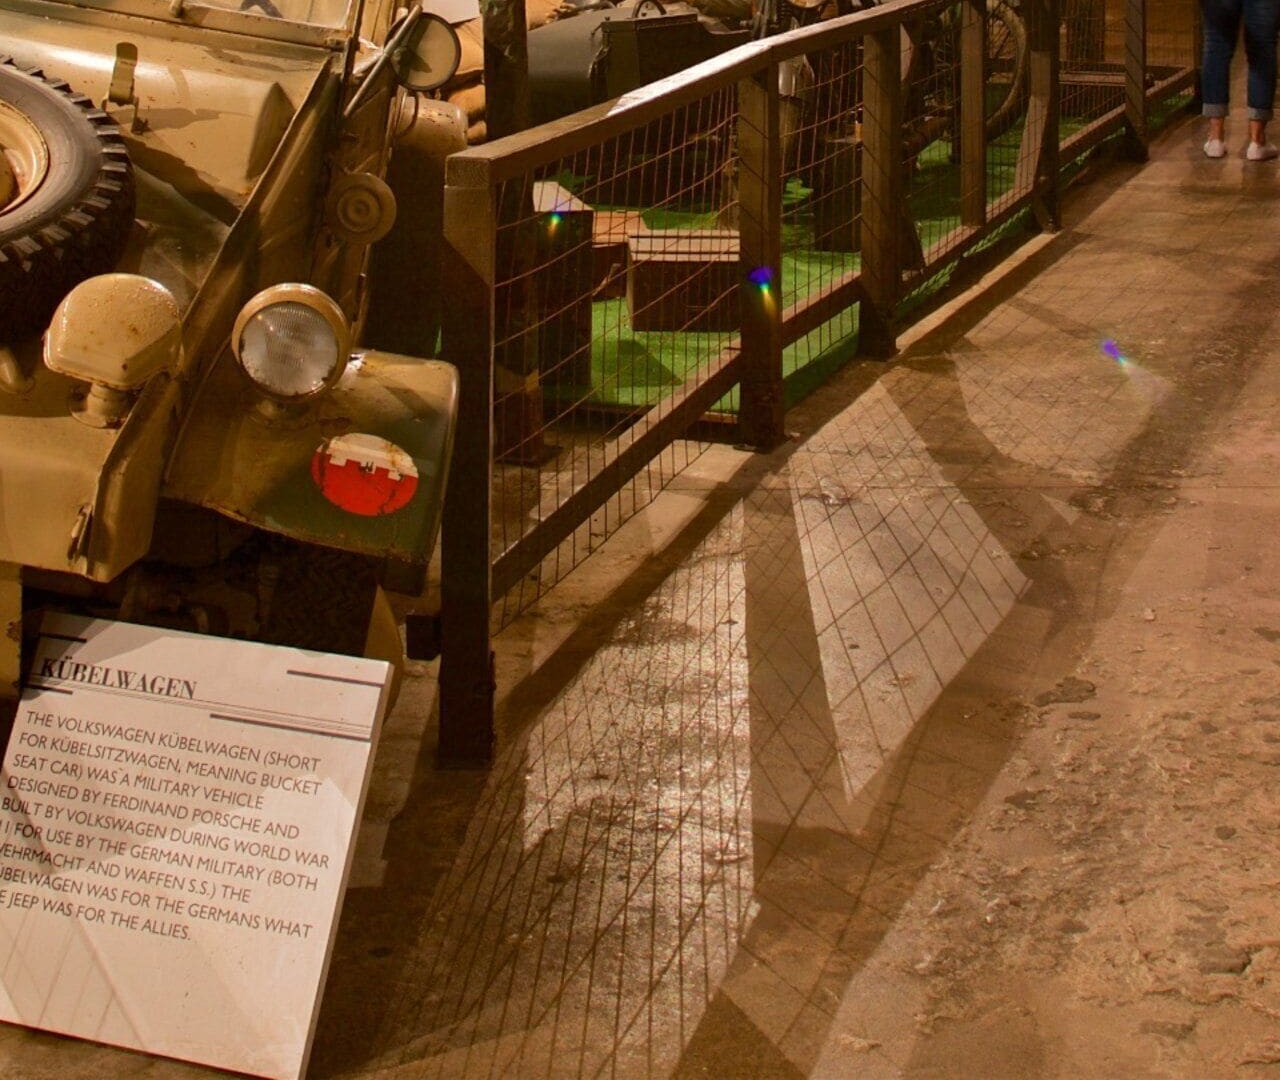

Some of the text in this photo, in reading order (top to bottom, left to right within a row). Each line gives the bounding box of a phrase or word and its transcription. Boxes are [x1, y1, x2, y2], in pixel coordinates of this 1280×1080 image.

[40, 656, 197, 699] KÜBELWAGEN
[19, 732, 47, 749] FOR
[186, 760, 258, 785] MEANING
[260, 774, 322, 796] BUCKET
[26, 710, 321, 771] THE VOLKSWAGEN KÜBELWAGEN (SHORT
[7, 775, 300, 839] DESIGNED BY FERDINAND PORSCHE AND
[13, 753, 264, 810] SEAT CAR) WAS A MILITARY VEHICLE
[1, 797, 330, 869] BUILT BY VOLKSWAGEN DURING WORLD WAR
[14, 822, 42, 841] FOR
[45, 828, 72, 846] USE
[75, 834, 95, 848] BY
[98, 838, 127, 856] THE
[130, 844, 194, 868] GERMAN
[196, 857, 266, 881] MILITARY
[267, 870, 318, 891] (BOTH
[86, 861, 120, 878] AND
[123, 867, 186, 890] WAFFEN
[221, 884, 252, 904] THE
[87, 882, 117, 902] WAS
[121, 889, 151, 909] FOR
[155, 896, 185, 915] THE
[188, 903, 261, 930] GERMANS
[264, 917, 313, 939] WHAT
[7, 893, 39, 910] JEEP
[43, 898, 73, 917] WAS
[75, 905, 105, 924] FOR
[111, 911, 139, 931] THE
[141, 919, 191, 941] ALLIES.
